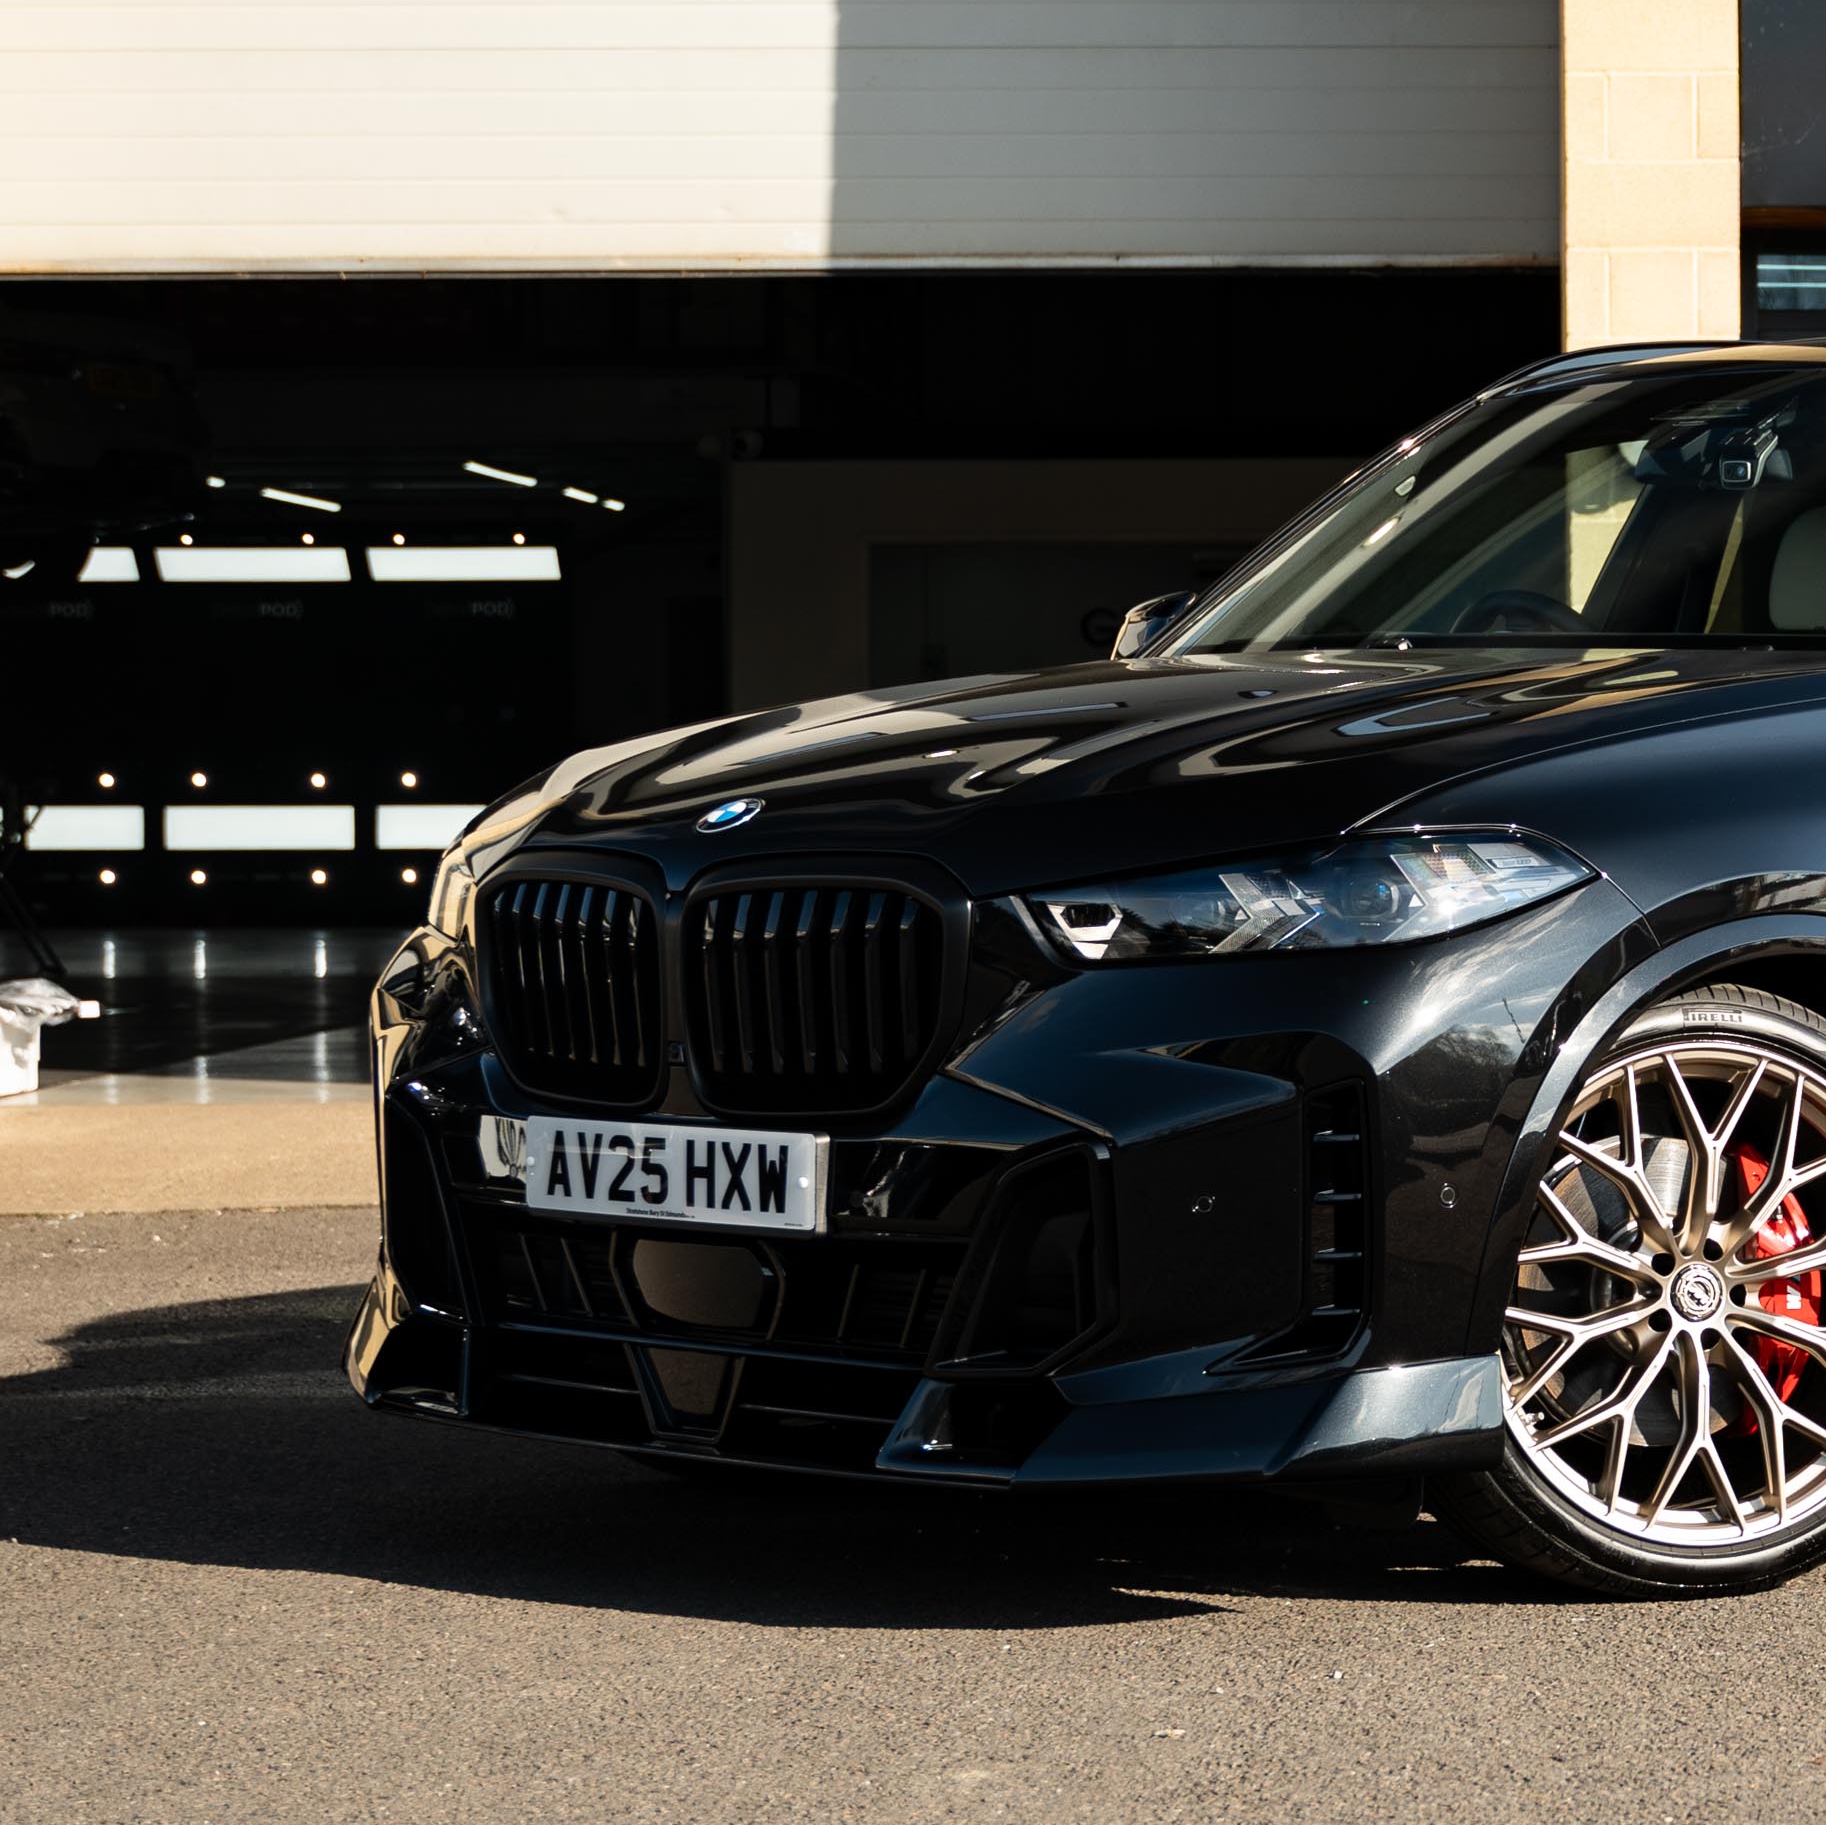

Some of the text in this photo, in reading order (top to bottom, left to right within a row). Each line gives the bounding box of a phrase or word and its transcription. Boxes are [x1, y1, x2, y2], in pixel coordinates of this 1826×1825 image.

[1682, 1008, 1743, 1022] PIRELLI
[548, 1130, 789, 1214] AV25 HXW
